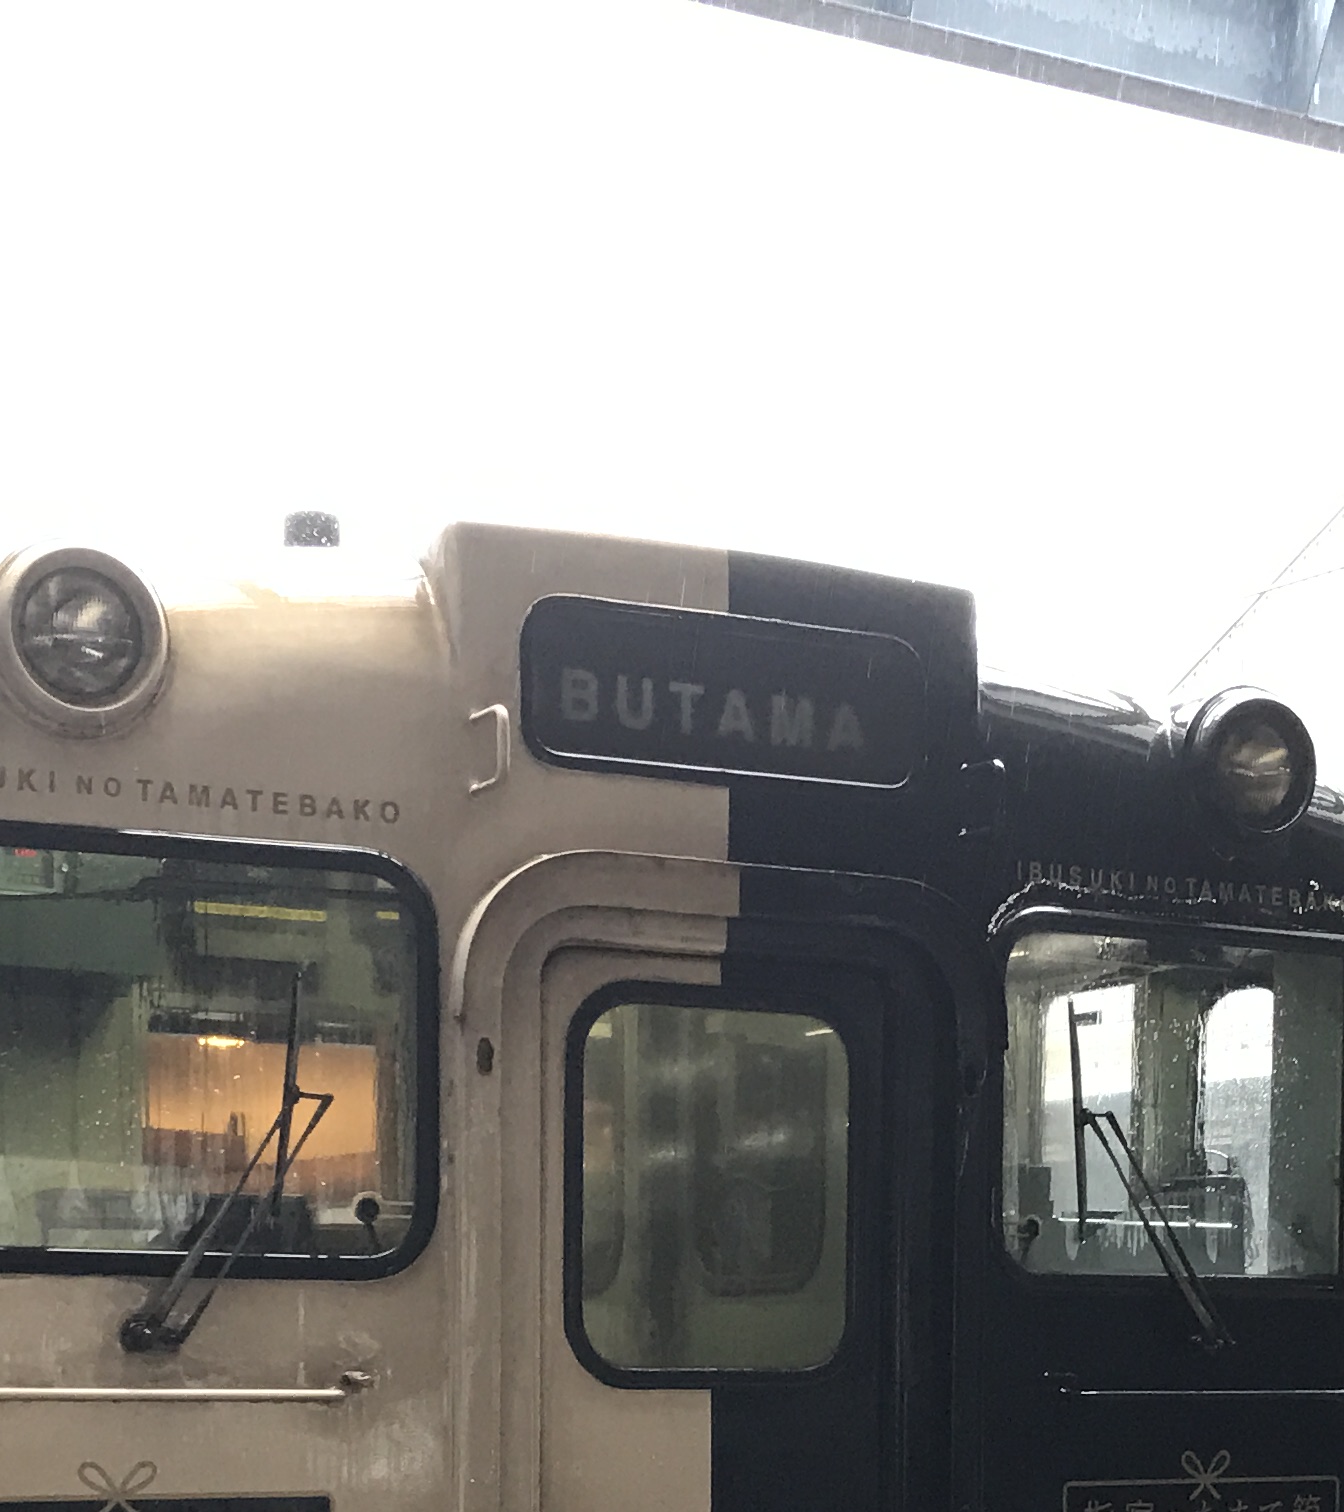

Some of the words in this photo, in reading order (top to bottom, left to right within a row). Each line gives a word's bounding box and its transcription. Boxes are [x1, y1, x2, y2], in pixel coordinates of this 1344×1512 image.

[75, 774, 122, 798] NO
[137, 778, 401, 825] TAMATEBAKO
[1015, 860, 1136, 890] IBUSUKI
[1147, 875, 1177, 896] NO
